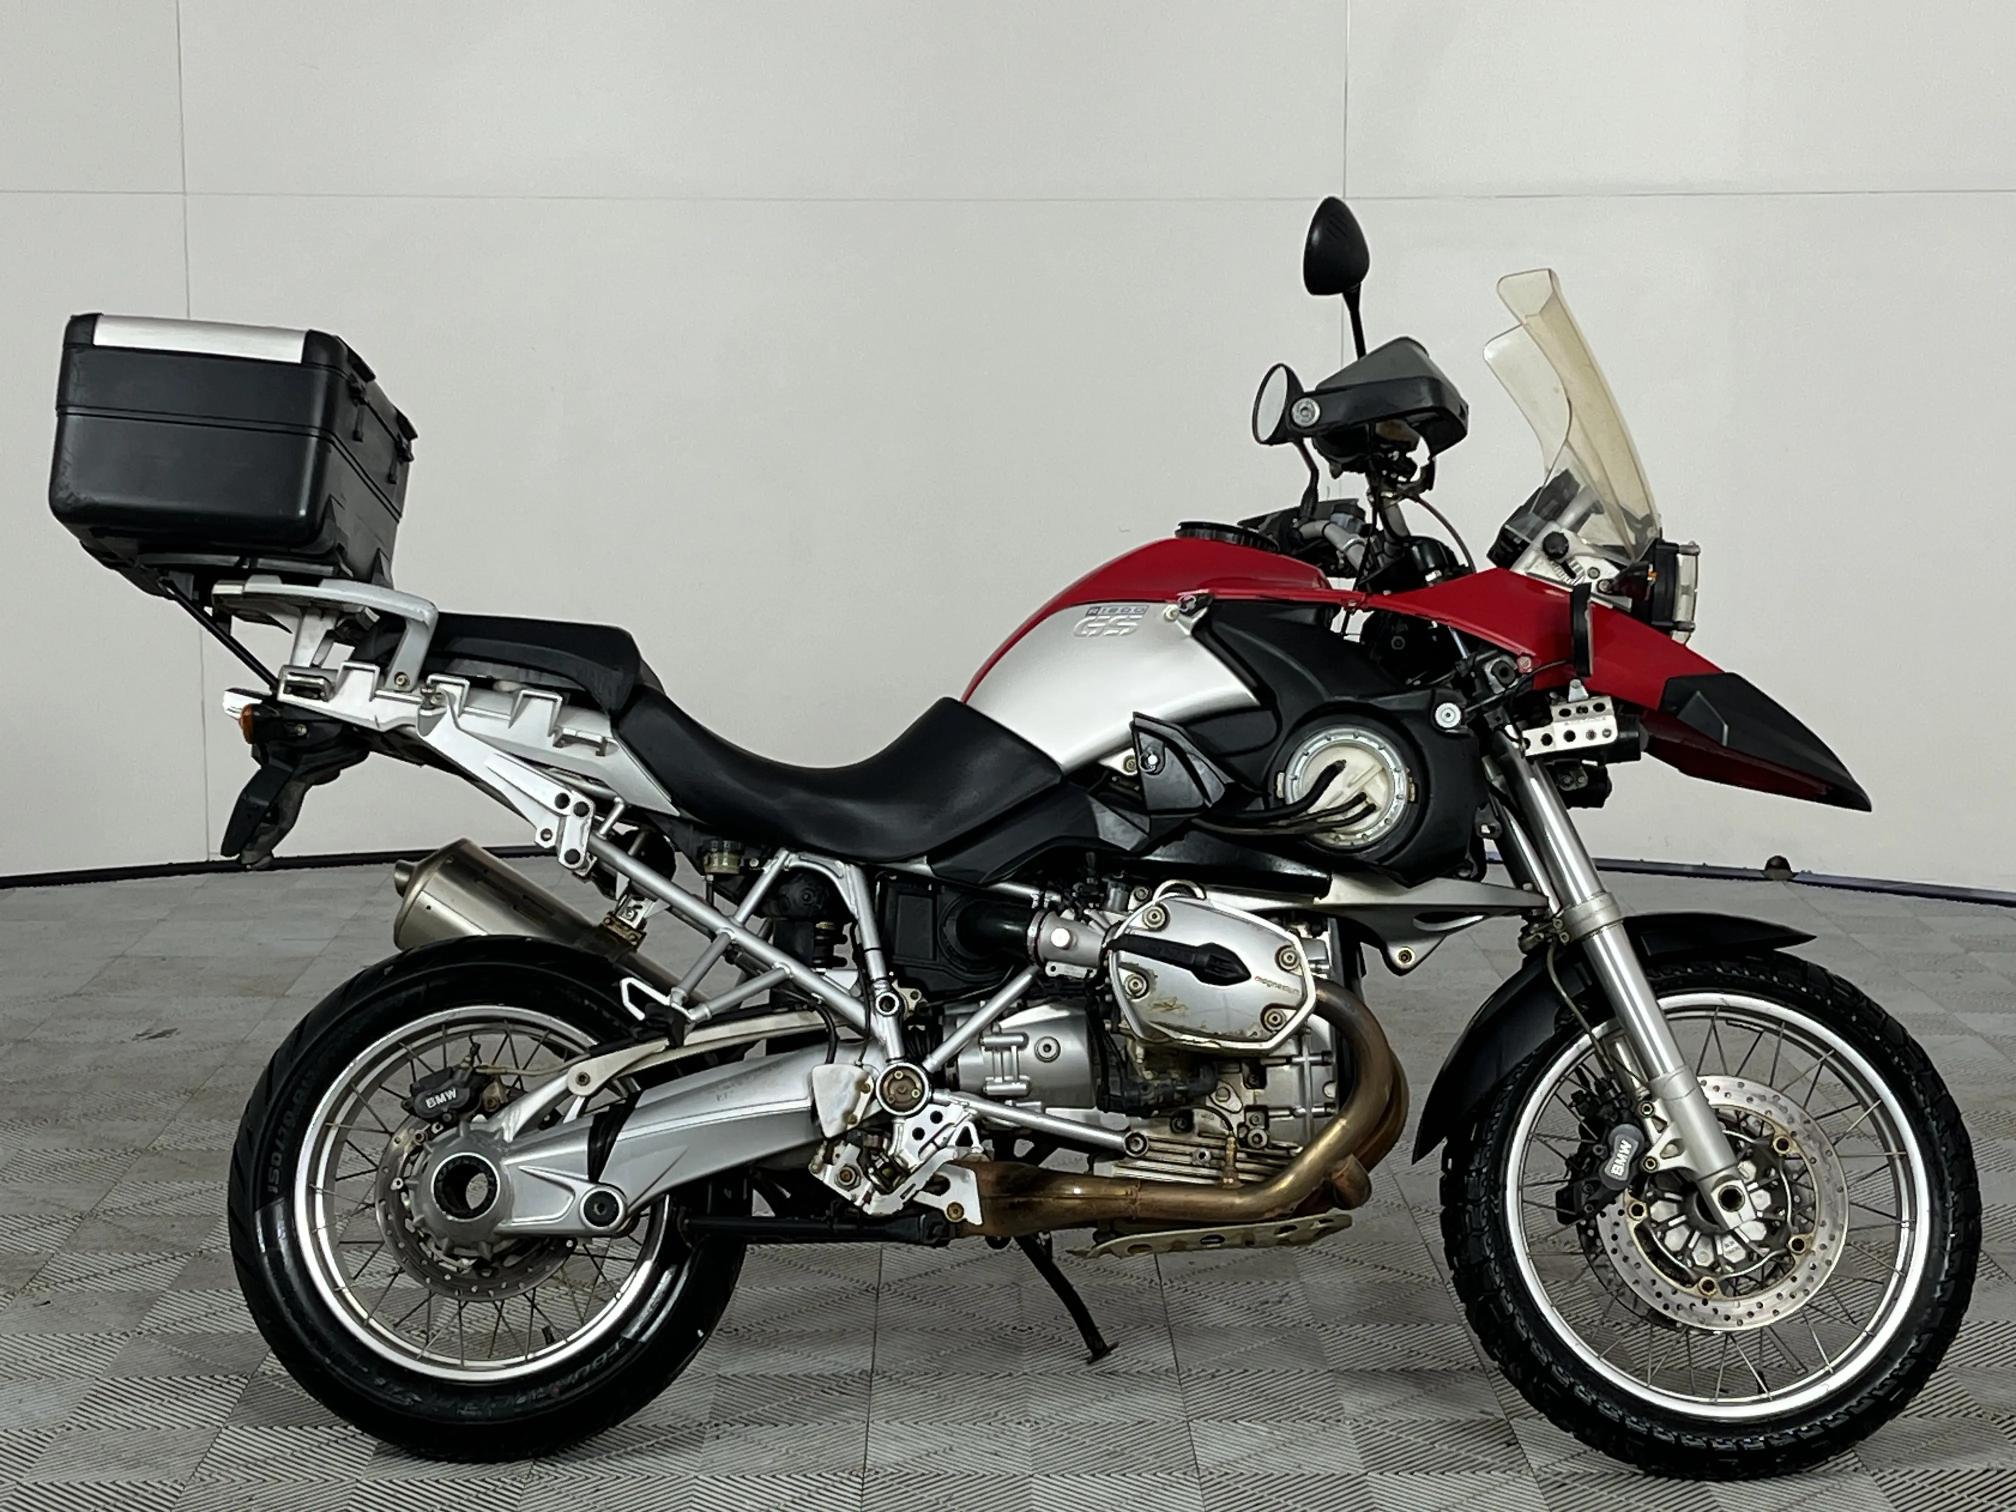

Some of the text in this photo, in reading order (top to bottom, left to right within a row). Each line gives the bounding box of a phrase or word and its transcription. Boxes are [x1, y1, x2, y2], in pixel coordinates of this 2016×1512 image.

[1074, 615, 1142, 637] GS
[425, 1087, 457, 1109] BMW
[1610, 1139, 1632, 1176] BMW
